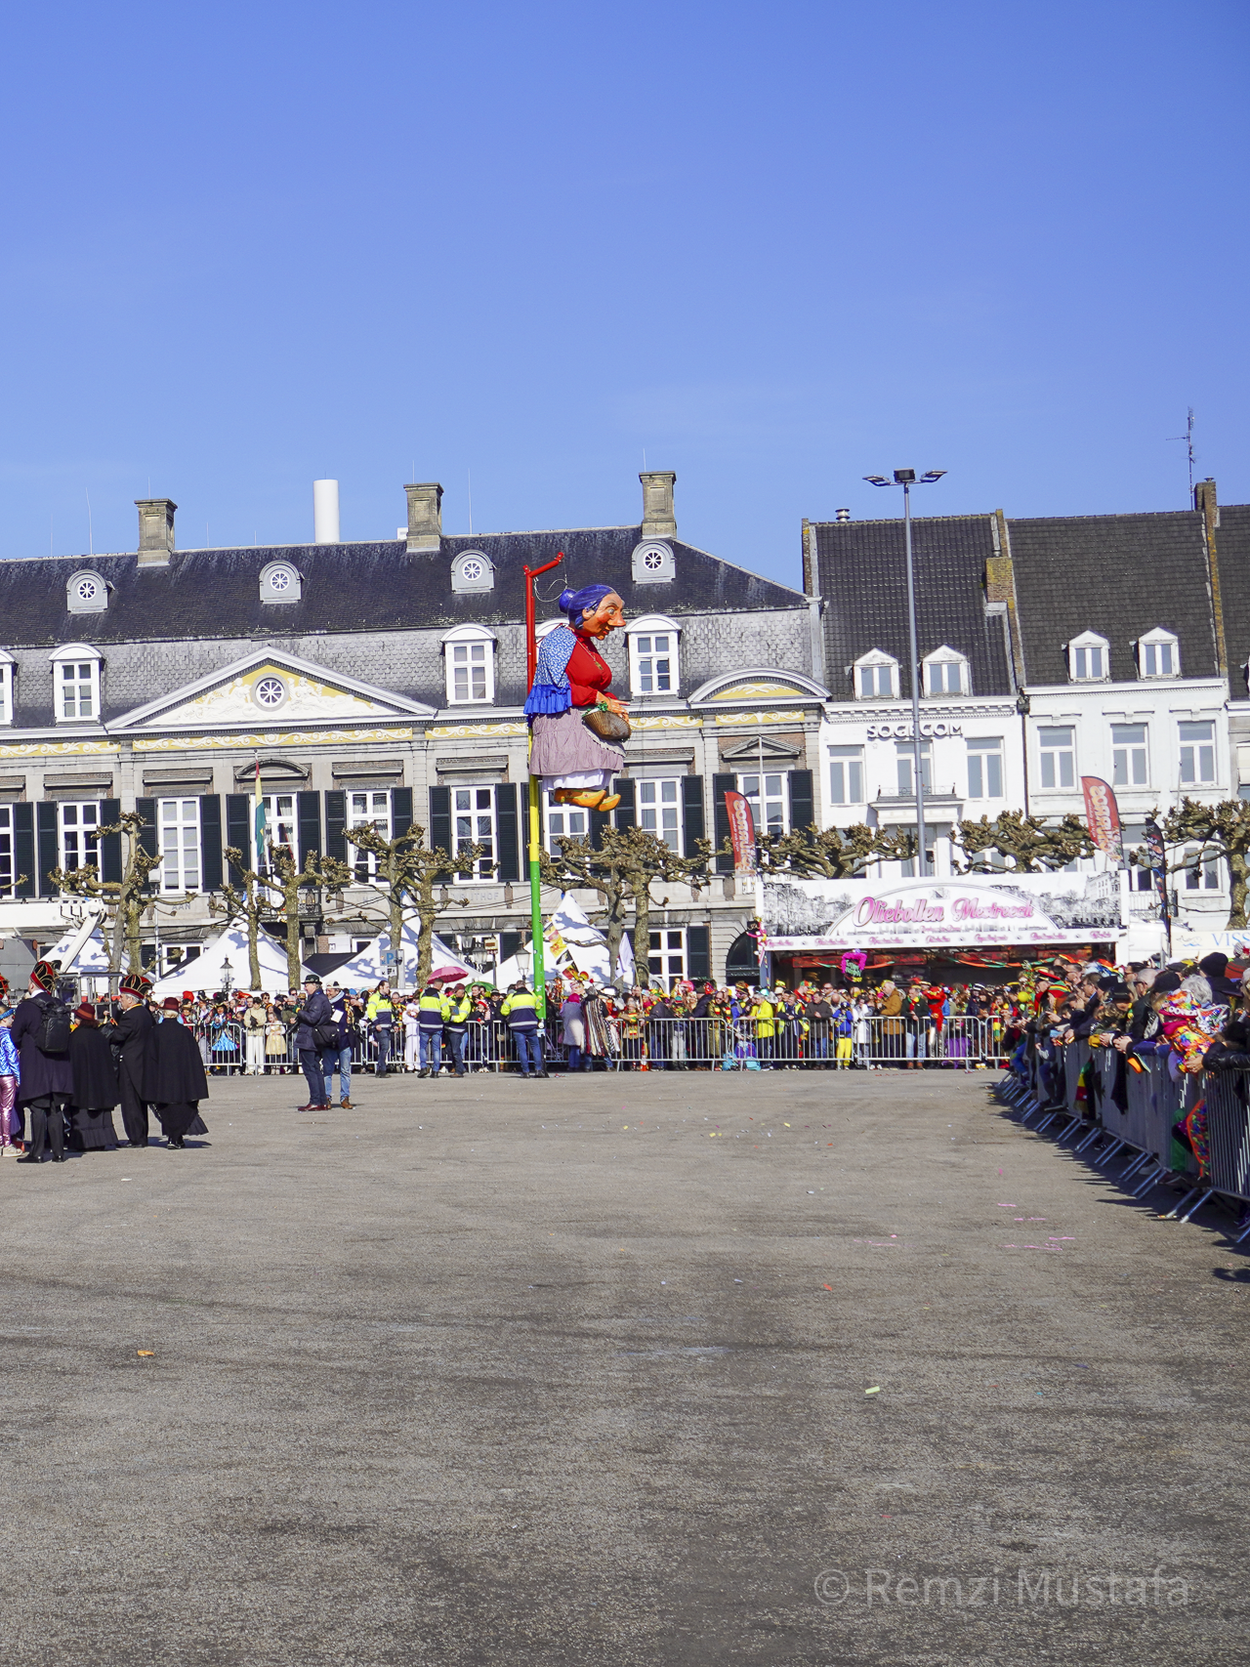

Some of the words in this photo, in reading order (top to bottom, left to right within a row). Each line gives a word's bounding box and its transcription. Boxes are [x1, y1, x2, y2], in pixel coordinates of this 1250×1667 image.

[852, 896, 944, 927] Oliebollen
[951, 897, 1034, 922] Mestreech
[386, 952, 394, 965] P
